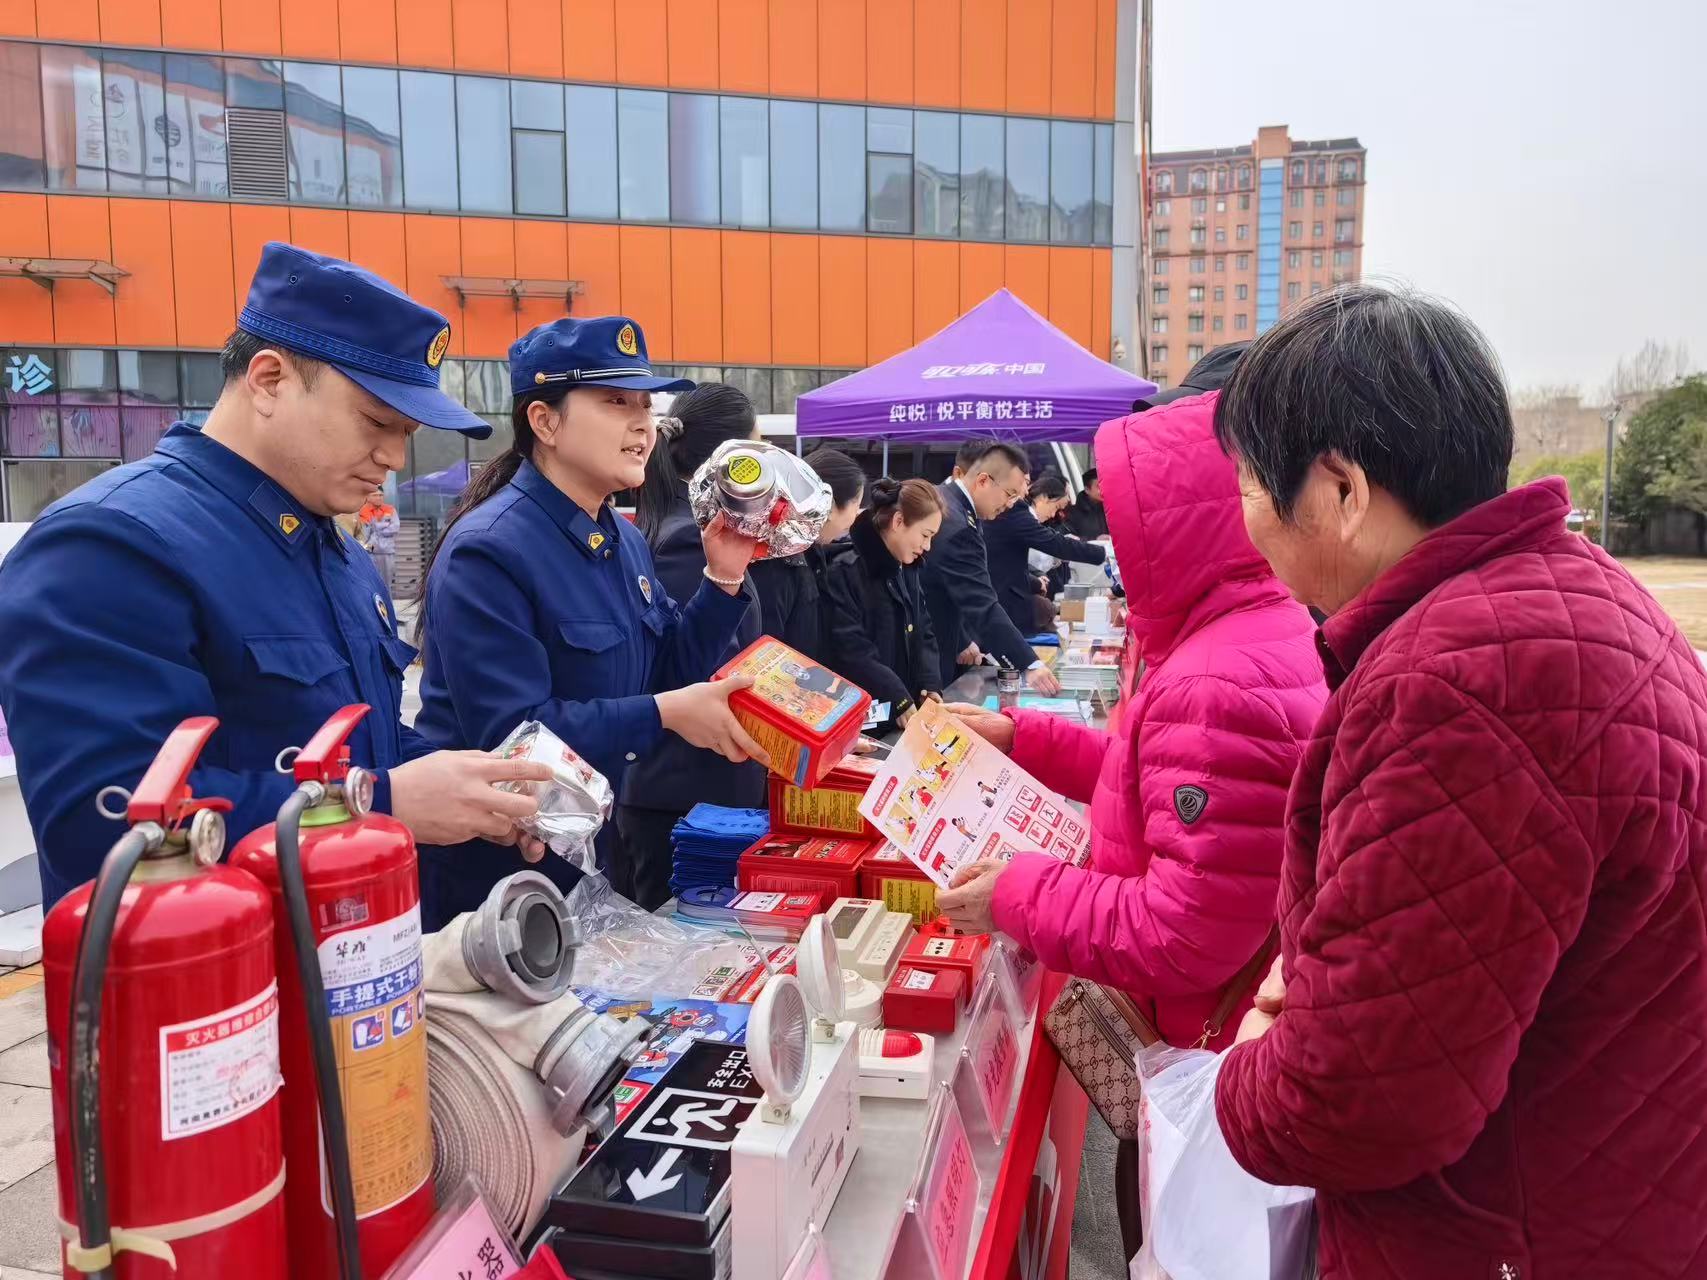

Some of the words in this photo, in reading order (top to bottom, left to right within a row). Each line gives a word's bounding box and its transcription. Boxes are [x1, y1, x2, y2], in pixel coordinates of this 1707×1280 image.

[4, 354, 54, 396] 诊
[889, 403, 928, 422] 纯悦
[937, 400, 1054, 421] 悦平衡悦生活
[331, 961, 423, 1008] 手提式干粉
[706, 1049, 746, 1088] 安全出口
